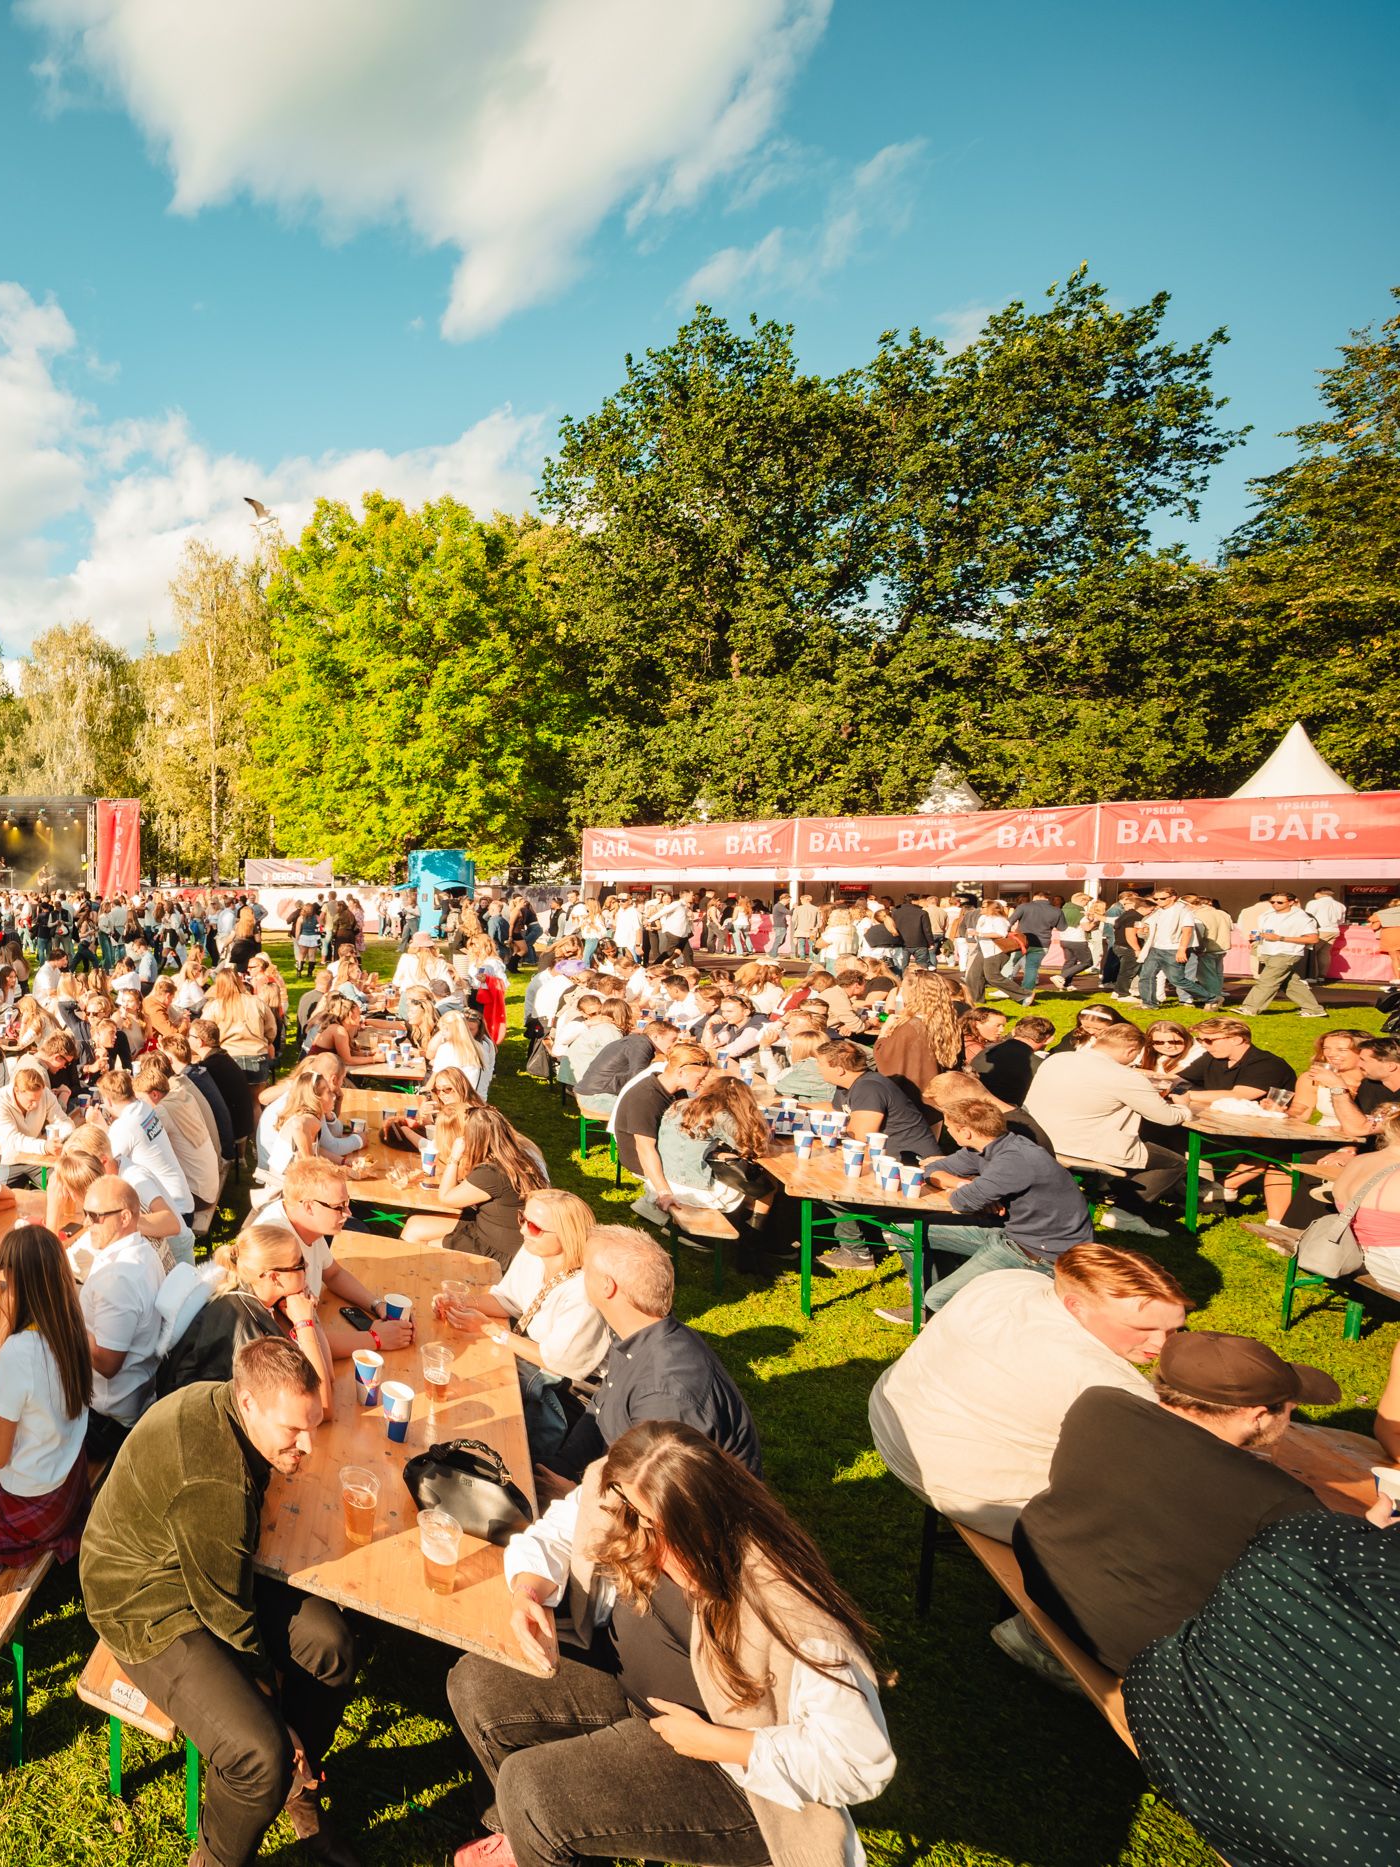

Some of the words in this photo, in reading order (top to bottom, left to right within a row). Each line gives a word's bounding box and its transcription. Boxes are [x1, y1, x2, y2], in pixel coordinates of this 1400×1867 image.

[997, 823, 1076, 849] BAR.
[1116, 818, 1208, 844] BAR.
[1250, 812, 1357, 841] BAR.
[592, 839, 637, 857] BAR.
[655, 837, 705, 857] BAR.
[725, 834, 782, 855] BAR.
[809, 831, 870, 853] BAR.
[898, 829, 967, 851] BAR.
